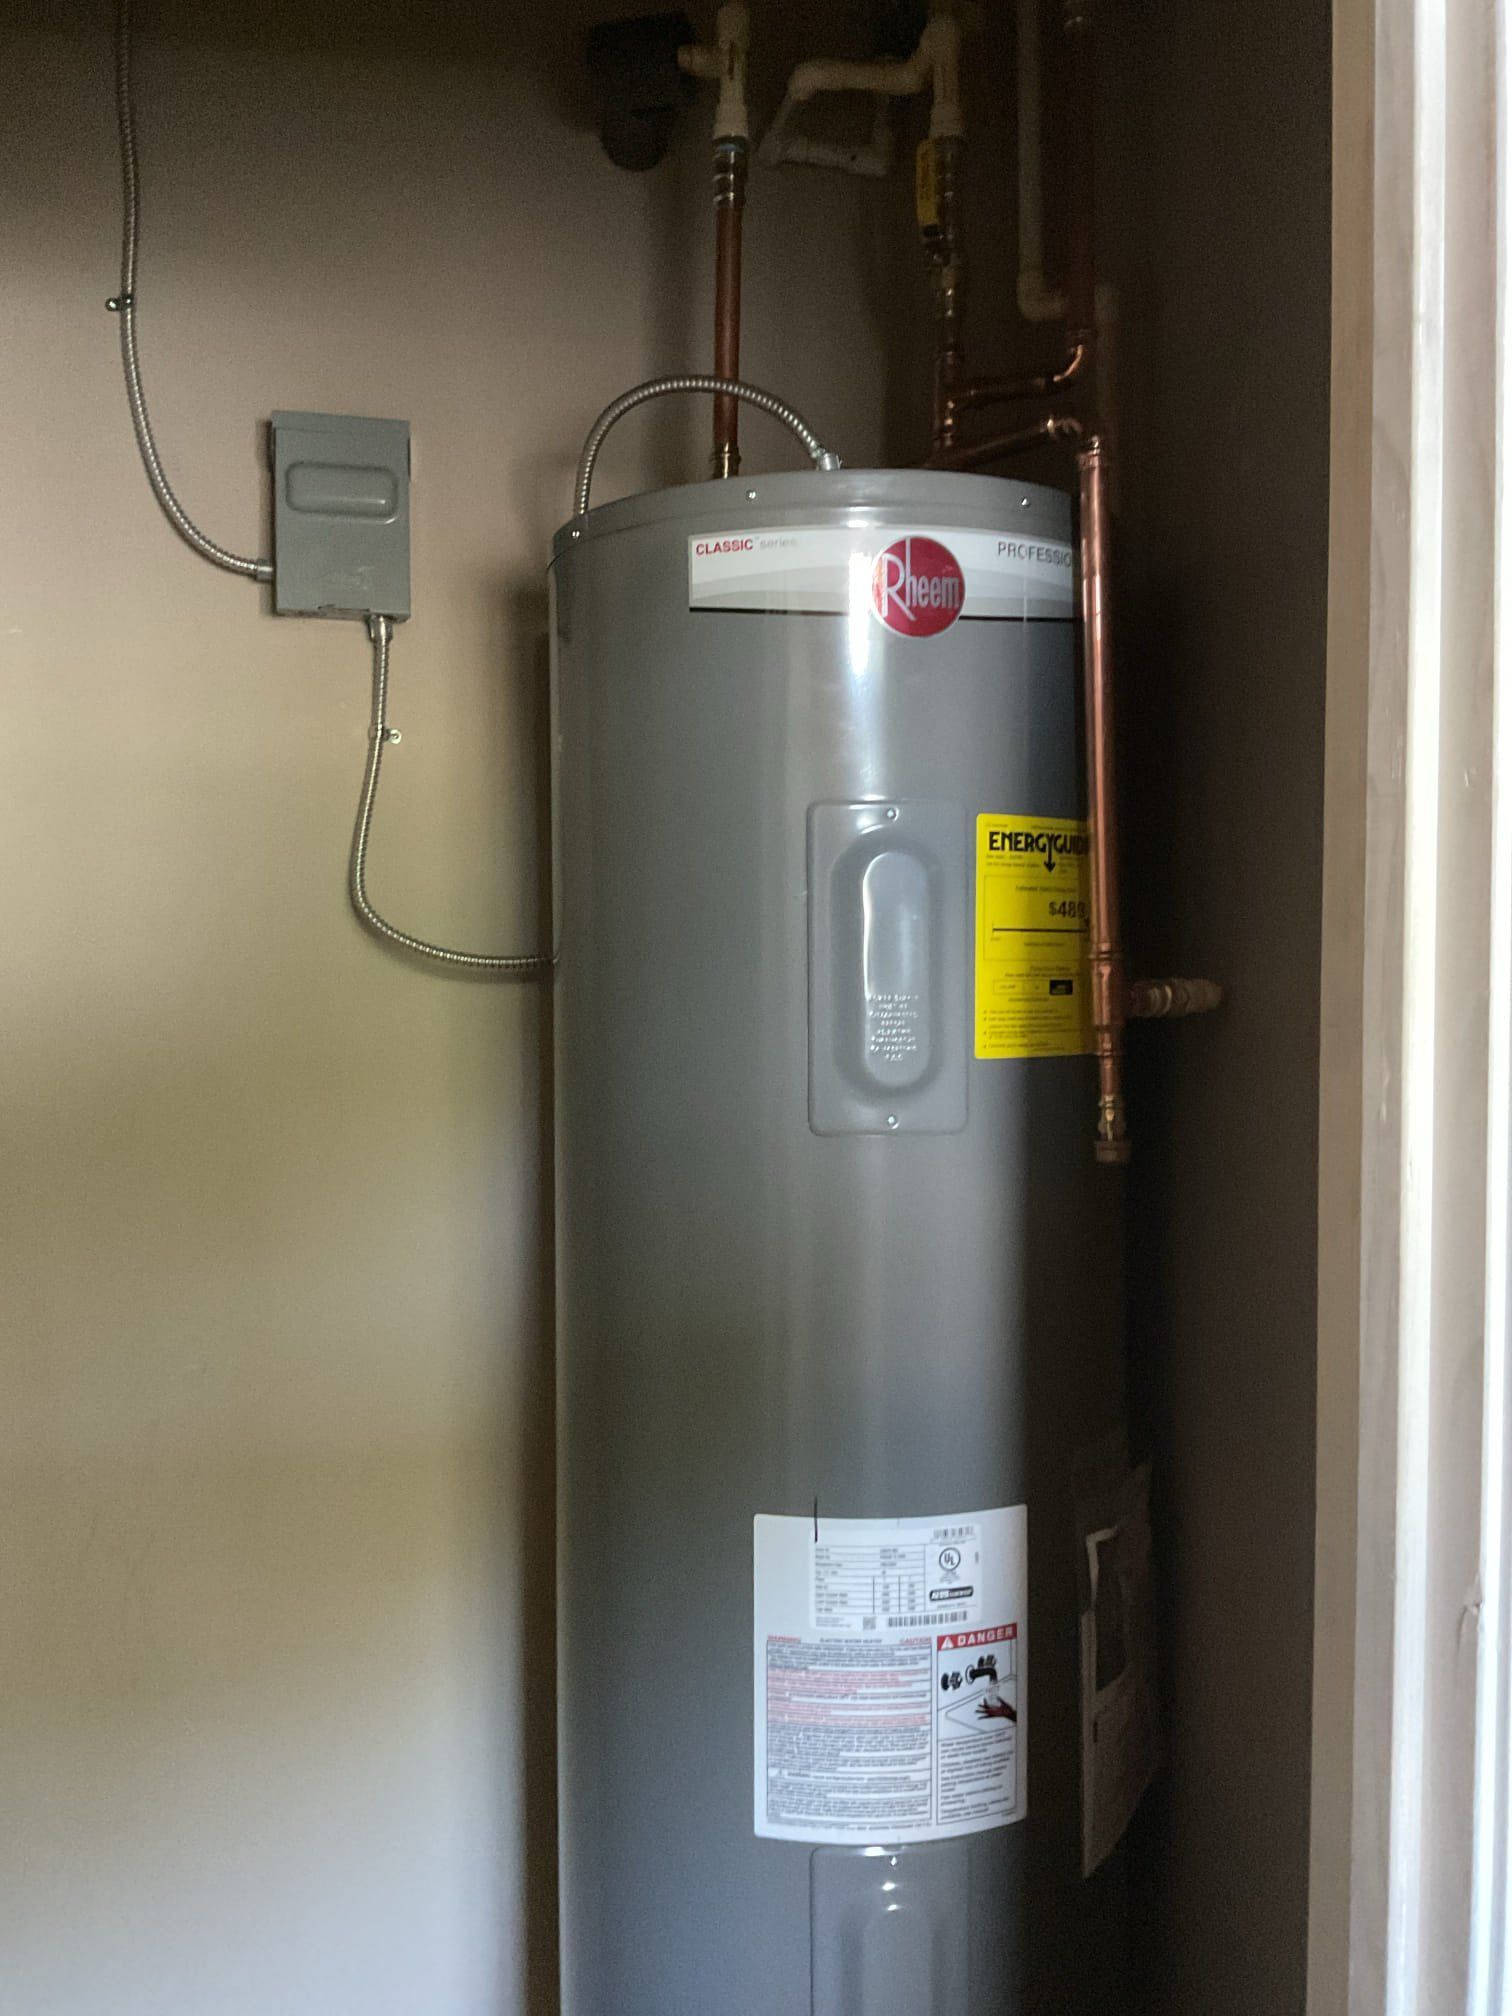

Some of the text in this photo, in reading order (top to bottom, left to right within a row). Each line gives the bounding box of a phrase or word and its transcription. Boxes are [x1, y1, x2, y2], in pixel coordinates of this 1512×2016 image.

[695, 538, 753, 556] CLASSIC
[881, 536, 960, 621] Rheem
[957, 1626, 1013, 1646] DANGER
